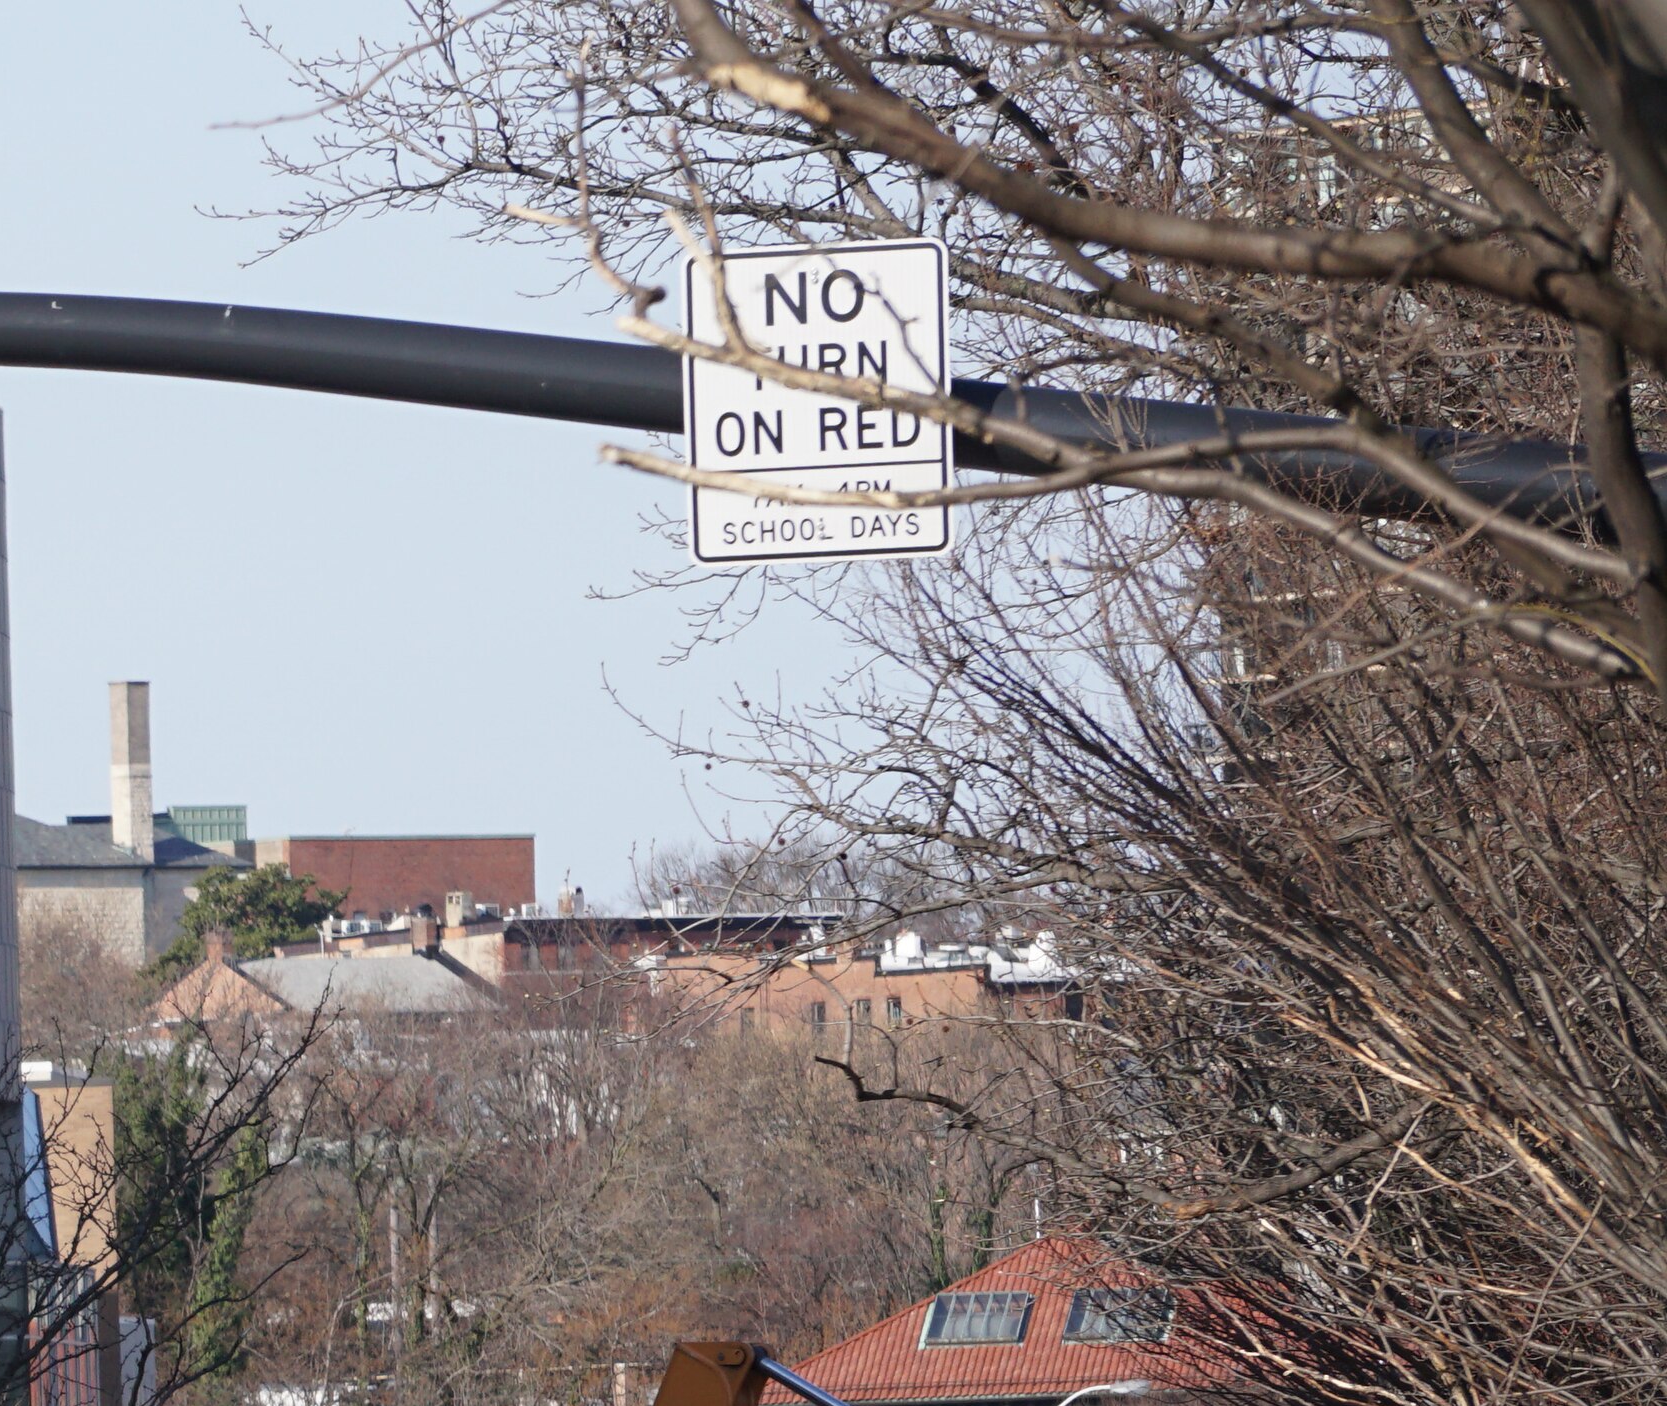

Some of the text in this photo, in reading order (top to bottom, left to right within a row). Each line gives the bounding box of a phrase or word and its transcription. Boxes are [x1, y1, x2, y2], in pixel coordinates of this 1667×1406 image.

[765, 269, 864, 326] NO
[755, 340, 887, 391] RN
[716, 404, 921, 457] ON RED
[851, 513, 920, 539] DAYS
